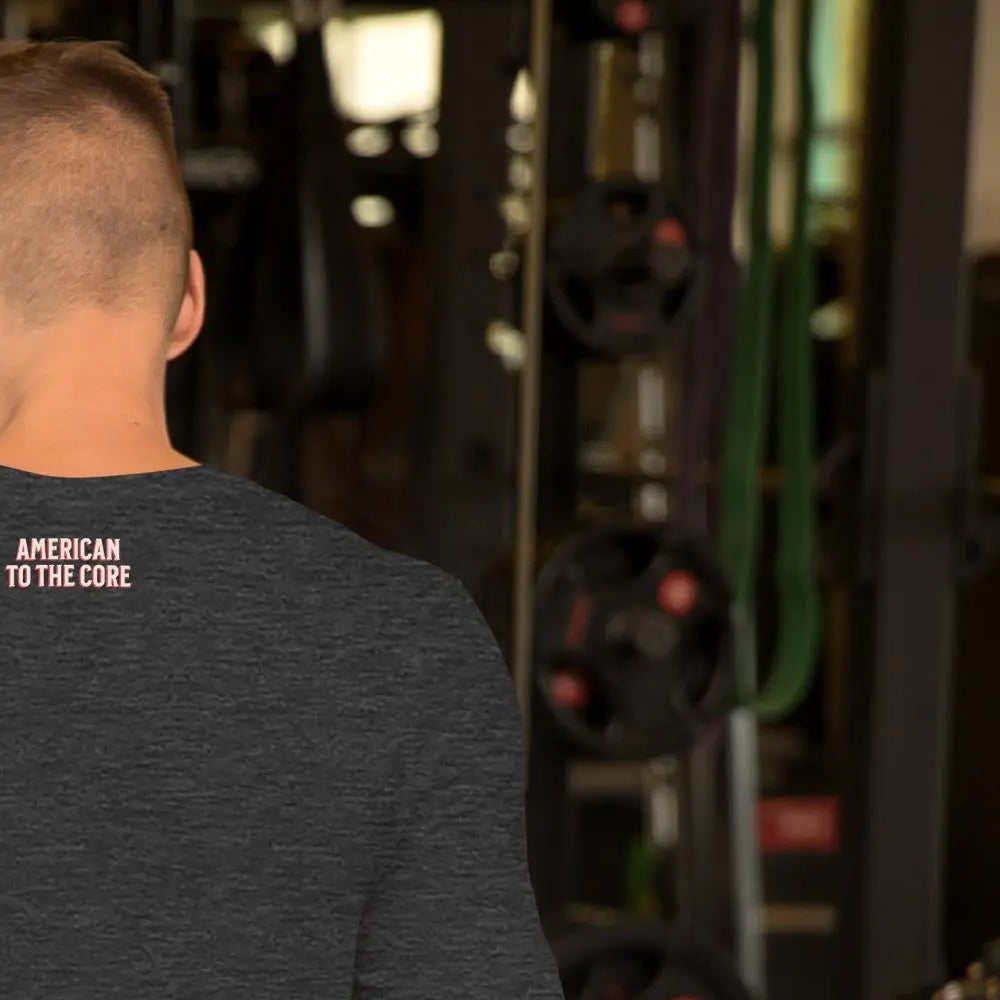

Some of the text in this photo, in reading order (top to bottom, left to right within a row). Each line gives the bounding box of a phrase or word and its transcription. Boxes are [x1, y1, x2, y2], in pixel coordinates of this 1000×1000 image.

[15, 537, 121, 561] AMERICAN
[5, 564, 132, 588] TO THE CORE
